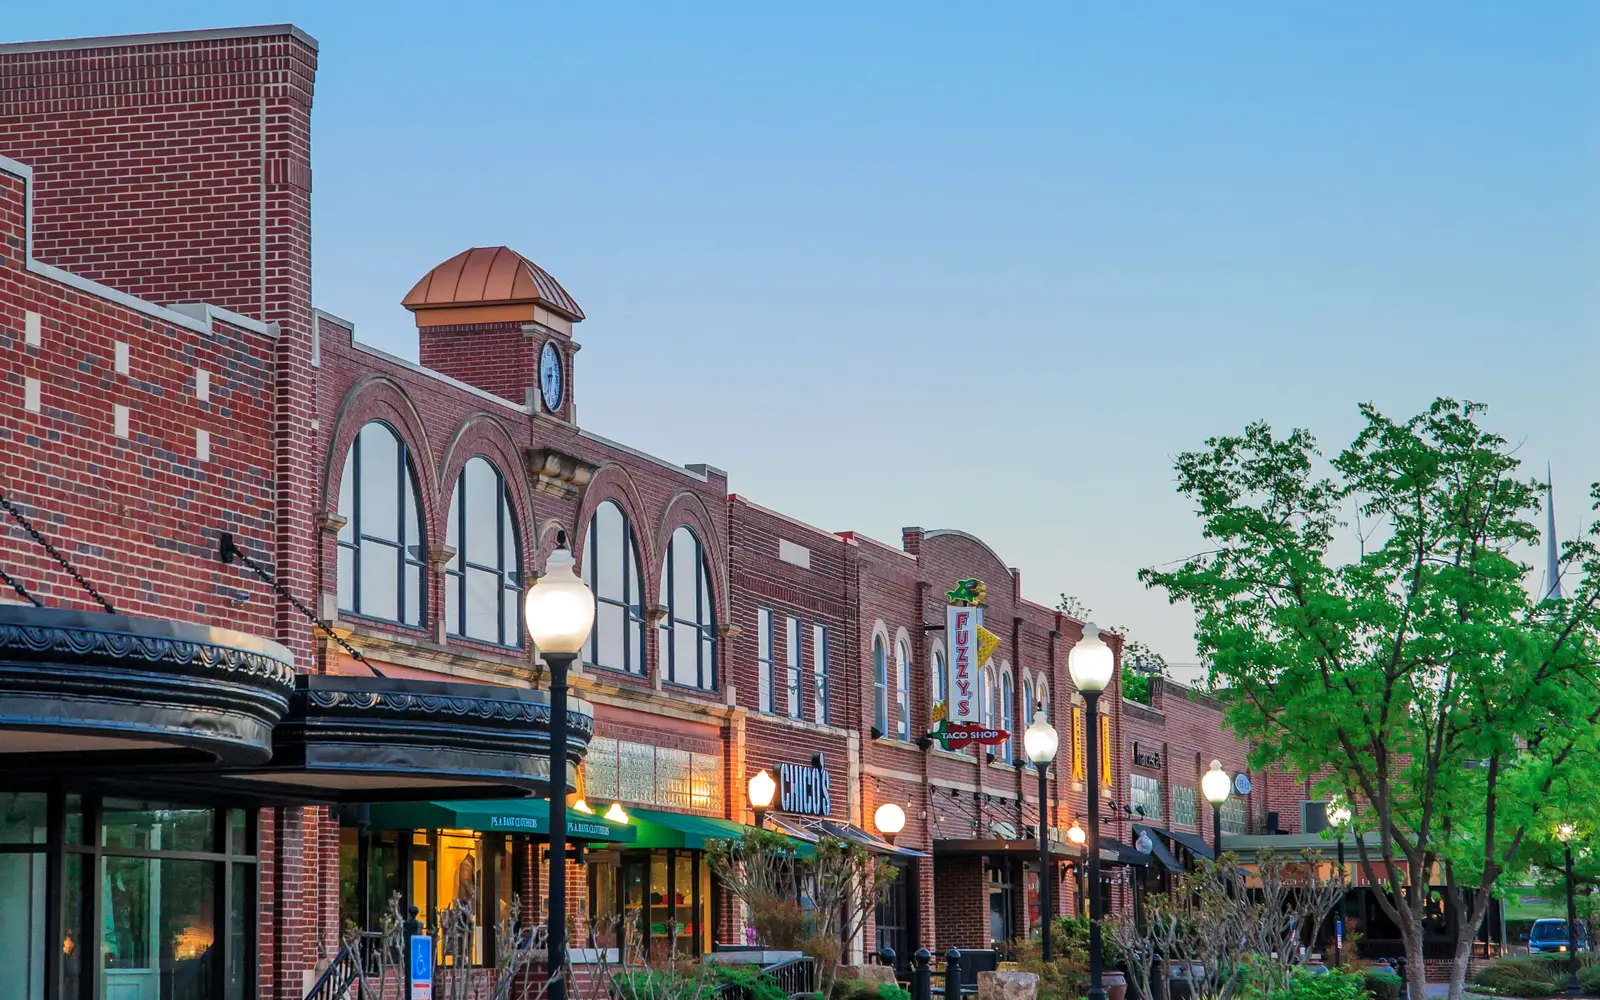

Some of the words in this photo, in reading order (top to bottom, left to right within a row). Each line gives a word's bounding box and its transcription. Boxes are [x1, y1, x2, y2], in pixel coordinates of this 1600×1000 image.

[955, 612, 973, 716] FUZZY'S
[940, 731, 968, 740] TACO
[970, 730, 999, 739] SHOP
[780, 752, 831, 816] CHICO'S
